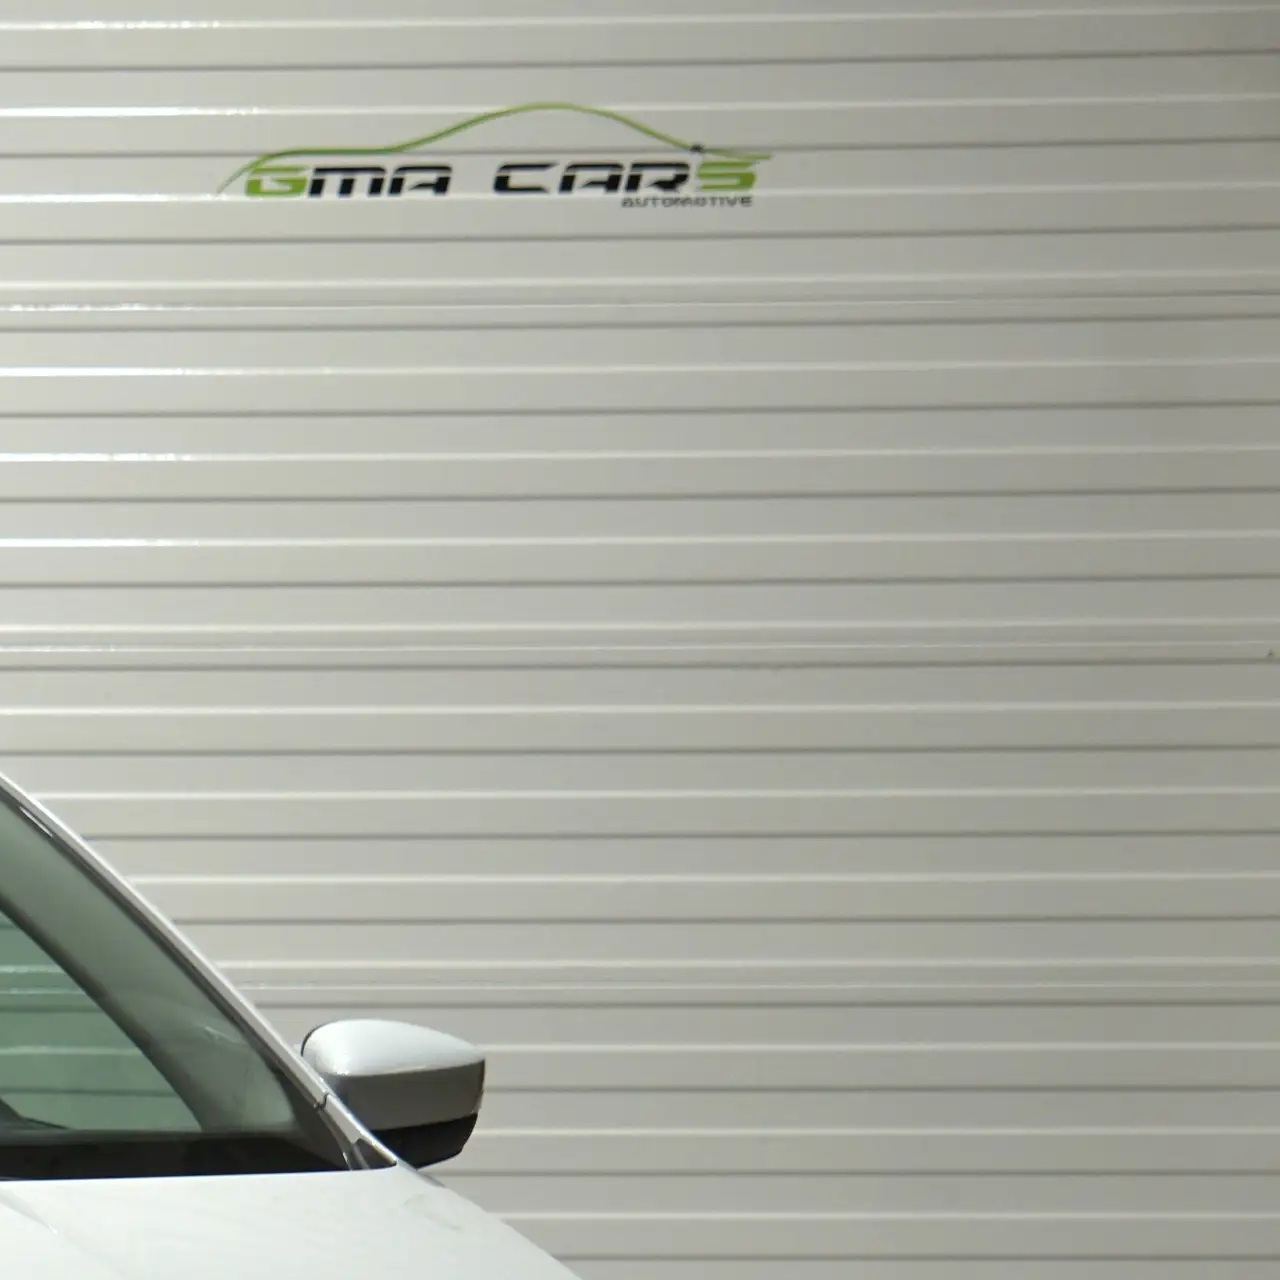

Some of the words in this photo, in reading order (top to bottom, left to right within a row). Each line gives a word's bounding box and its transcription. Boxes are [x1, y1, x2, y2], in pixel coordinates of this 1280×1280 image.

[246, 164, 453, 197] GMA
[493, 160, 758, 194] CARS
[621, 195, 754, 208] AUTOMOTIVE
